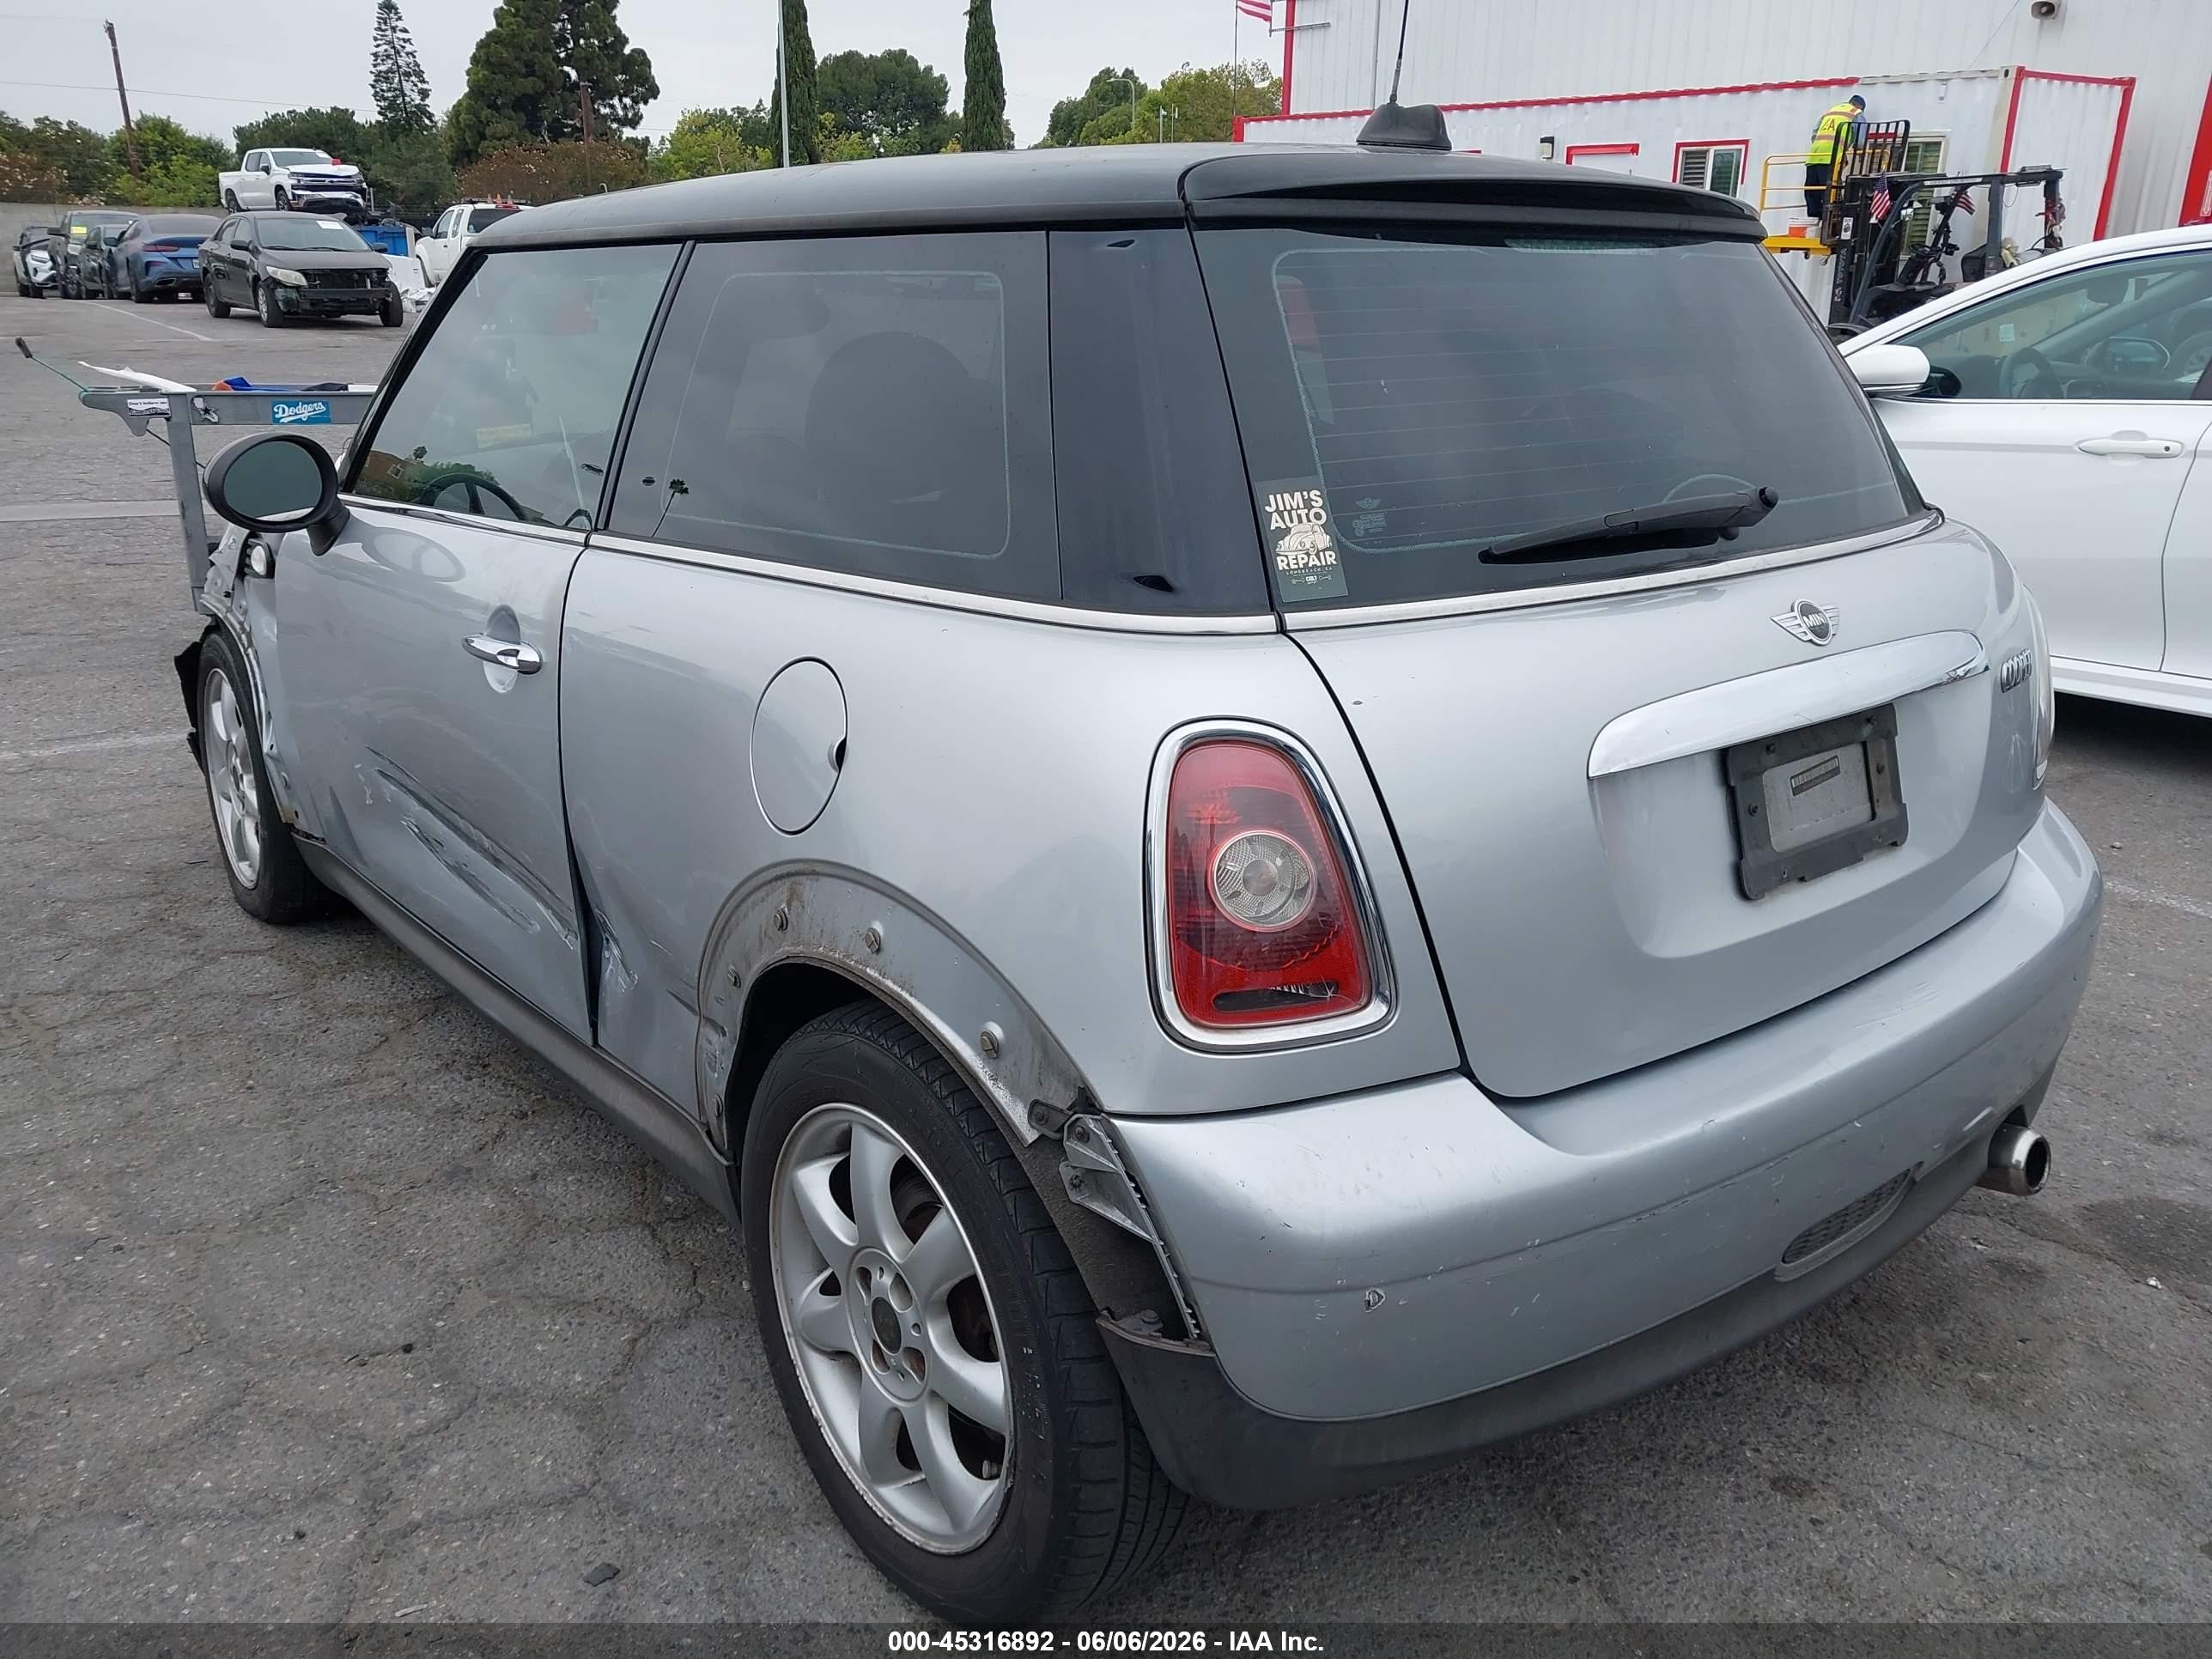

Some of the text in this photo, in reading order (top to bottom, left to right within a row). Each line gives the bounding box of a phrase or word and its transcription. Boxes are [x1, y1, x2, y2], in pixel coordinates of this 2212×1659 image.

[273, 401, 326, 422] Dodgers
[1264, 489, 1323, 513] JIM'S
[1270, 507, 1328, 531] AUTO
[1276, 550, 1337, 571] REPAIR
[1802, 613, 1828, 628] MINI
